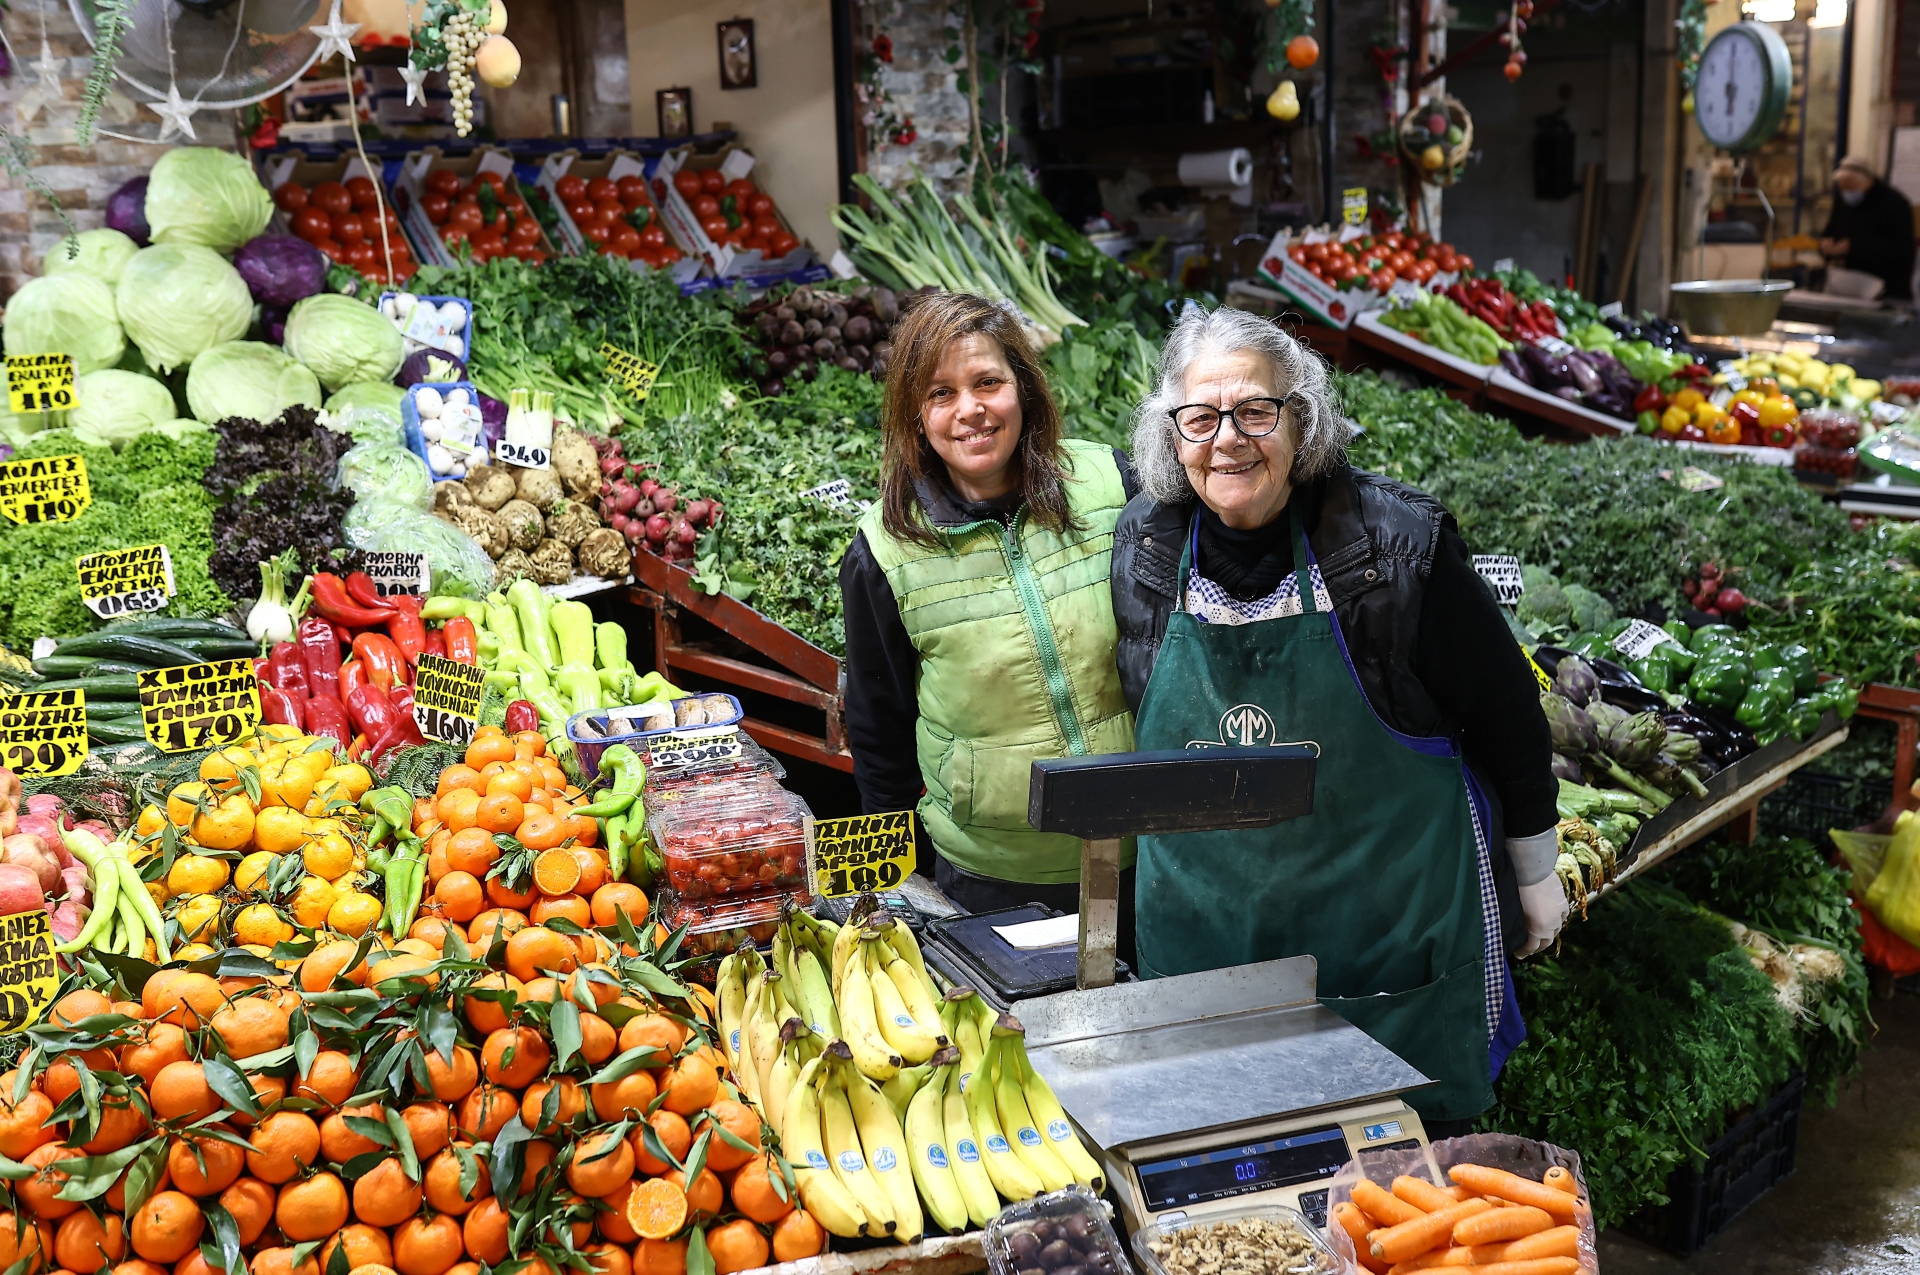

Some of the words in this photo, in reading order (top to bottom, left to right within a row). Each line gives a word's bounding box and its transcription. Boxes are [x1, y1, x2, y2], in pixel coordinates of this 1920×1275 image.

[501, 444, 547, 465] 249
[0, 742, 66, 775] 29
[825, 862, 902, 896] 189
